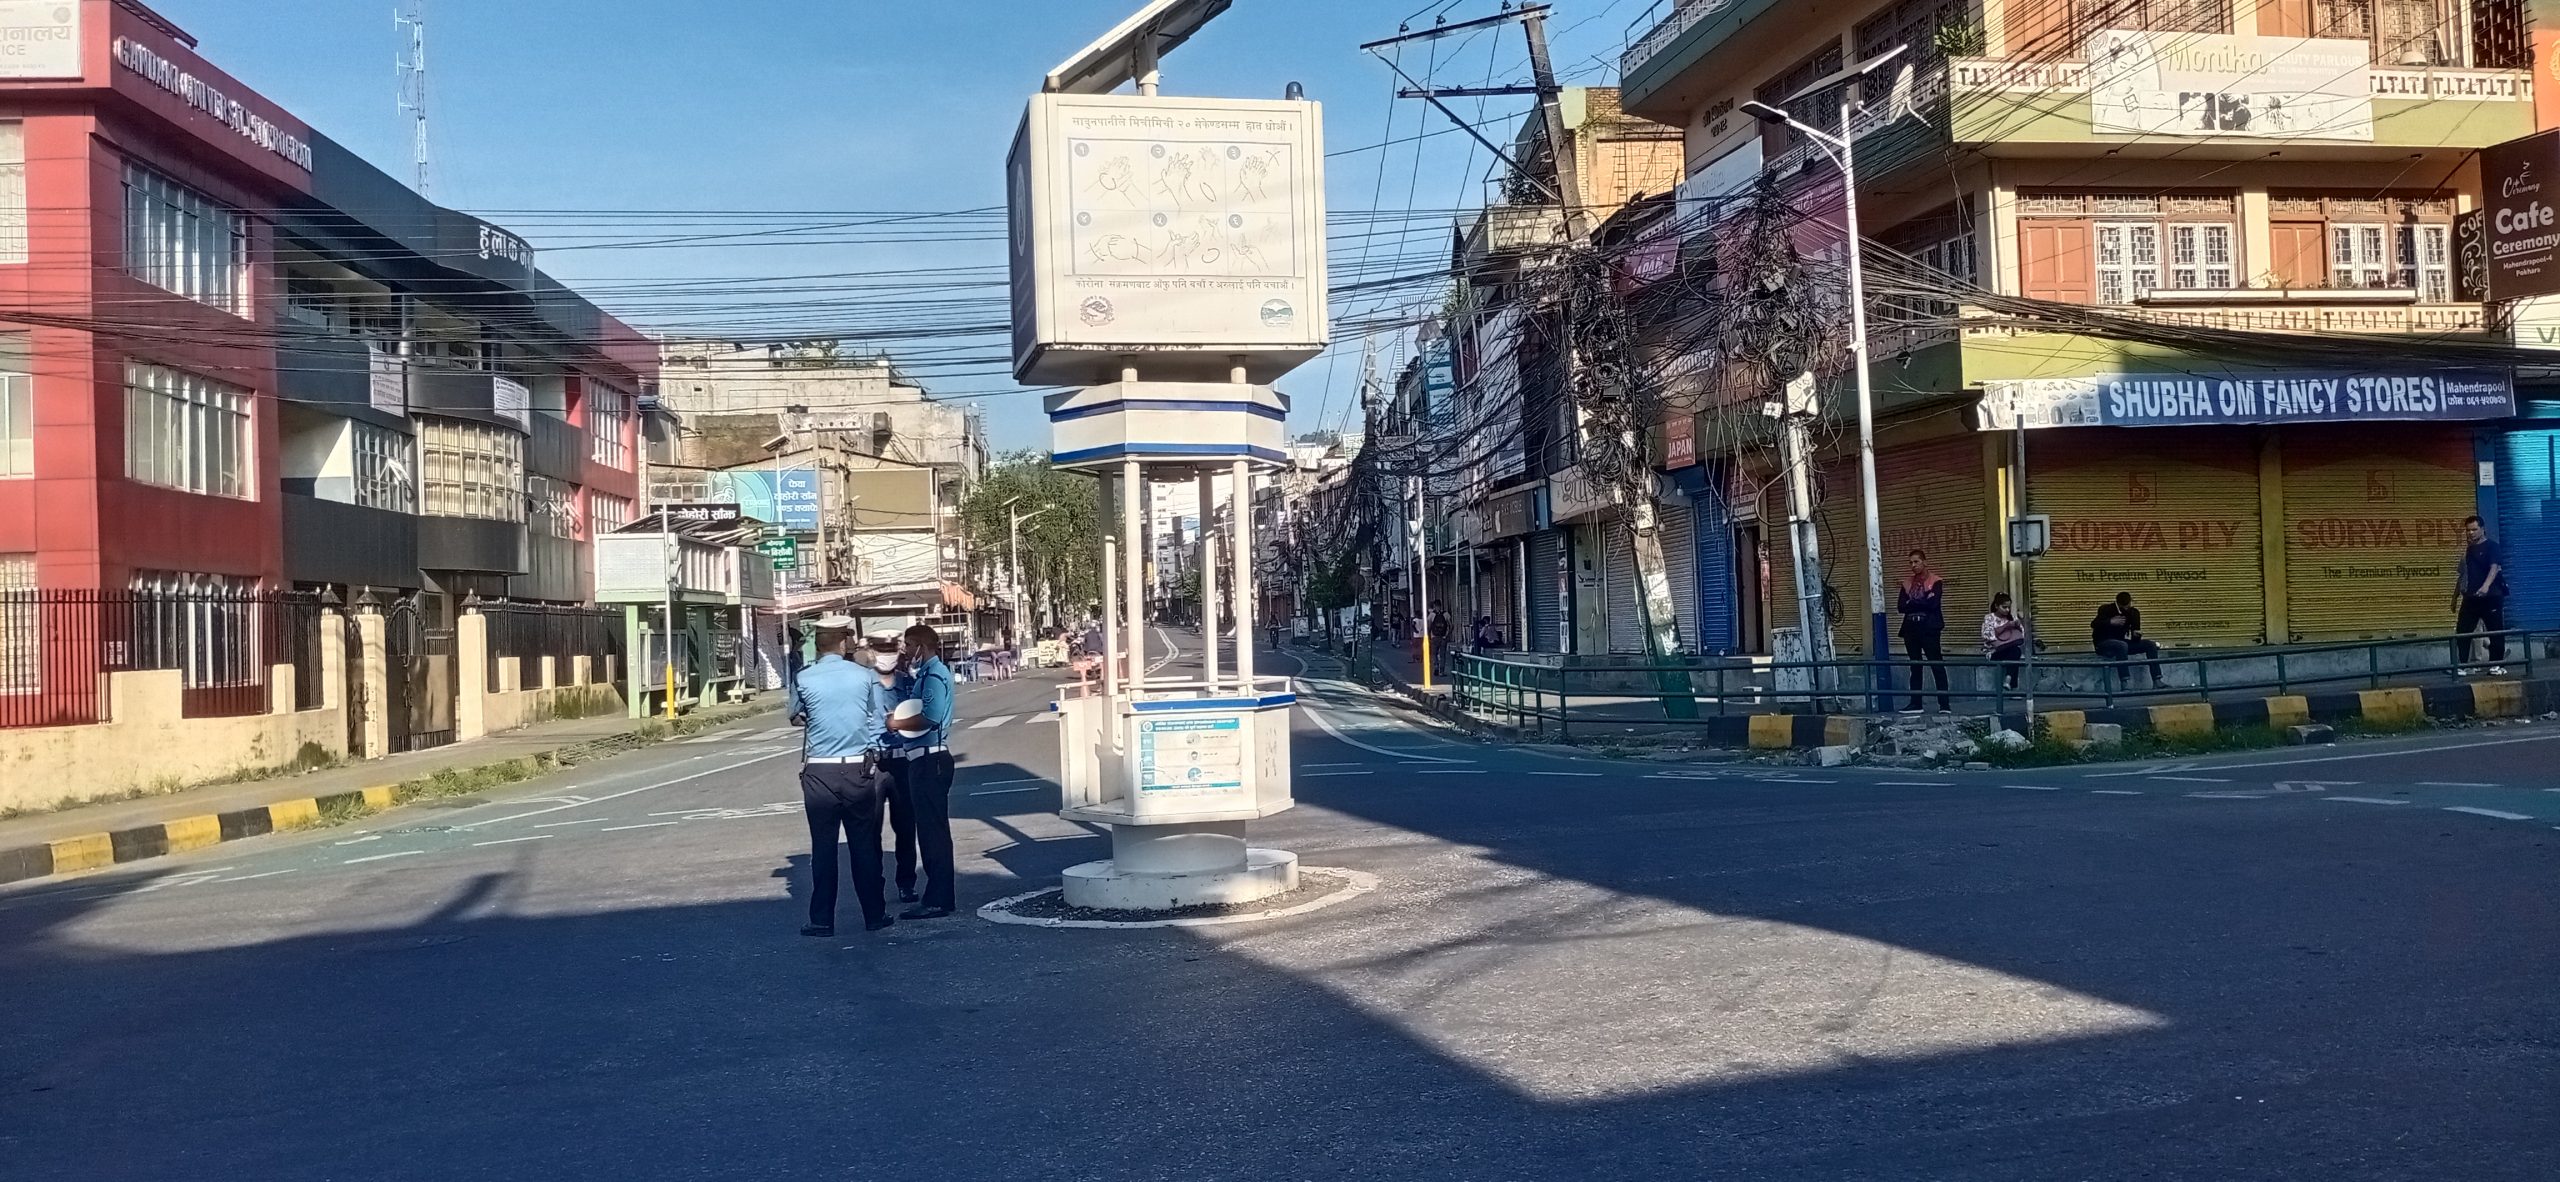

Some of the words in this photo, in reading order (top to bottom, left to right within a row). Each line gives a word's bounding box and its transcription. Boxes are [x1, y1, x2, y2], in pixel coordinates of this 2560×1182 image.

[118, 35, 179, 95] GANDAKI
[2165, 41, 2268, 75] Monika
[2313, 54, 2362, 67] PARLOUR
[2495, 201, 2554, 234] Cafe
[2493, 231, 2560, 255] Ceremony
[2515, 267, 2541, 277] Pokhara
[2109, 381, 2213, 418] SHUBHA
[2219, 380, 2254, 416] OM
[2261, 379, 2339, 415] FANCY
[2346, 376, 2436, 412] STORES
[2446, 381, 2506, 395] Mahendrapool
[1668, 438, 1693, 459] JAPAN
[2049, 519, 2168, 550] SURYA
[2178, 520, 2241, 550] PLY
[2297, 518, 2407, 548] SURYA
[2075, 569, 2095, 581] The
[2100, 569, 2148, 581] Premium
[2155, 568, 2207, 583] Plywood
[2322, 566, 2342, 578] The
[2349, 565, 2393, 578] Premium
[2396, 565, 2440, 580] Plywood
